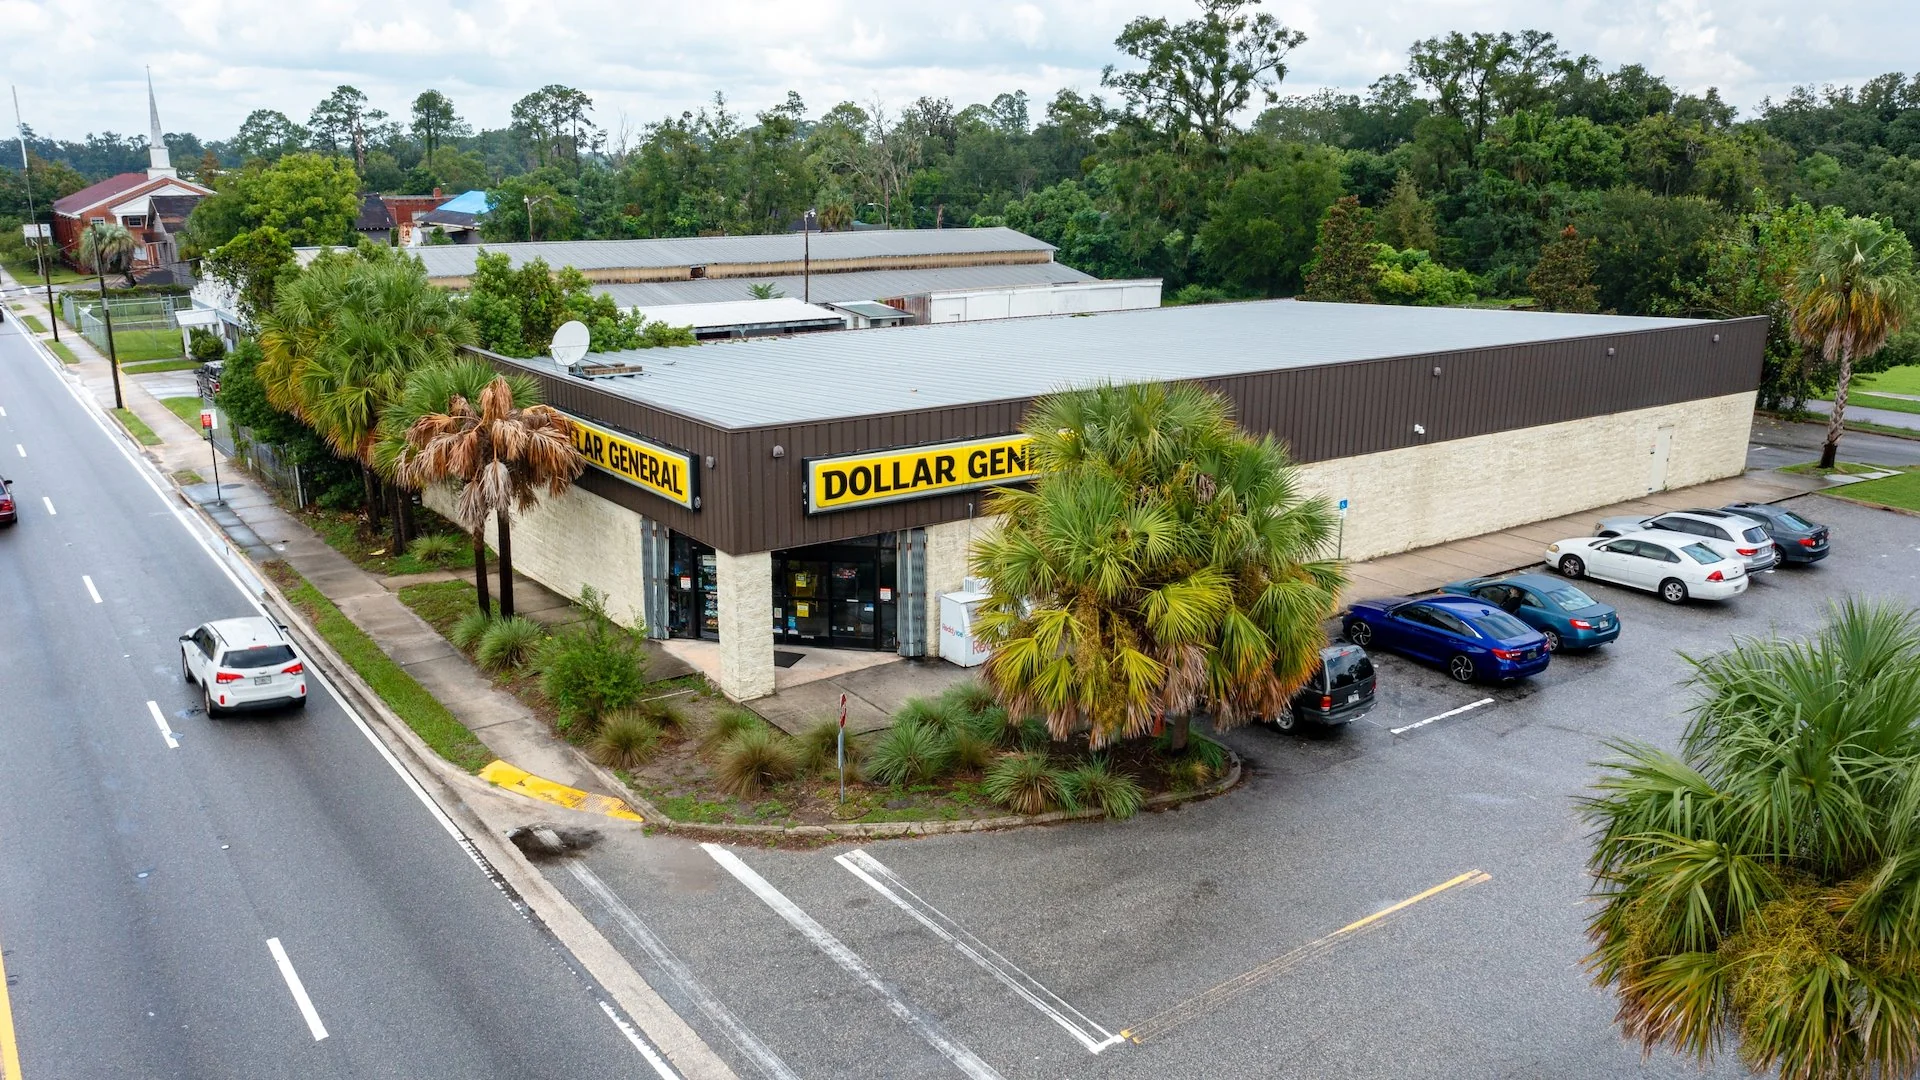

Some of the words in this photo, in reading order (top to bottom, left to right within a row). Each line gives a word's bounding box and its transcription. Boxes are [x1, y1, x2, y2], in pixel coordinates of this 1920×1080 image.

[575, 430, 604, 464] LAR
[608, 441, 683, 496] GENERAL
[822, 456, 956, 501] DOLLAR
